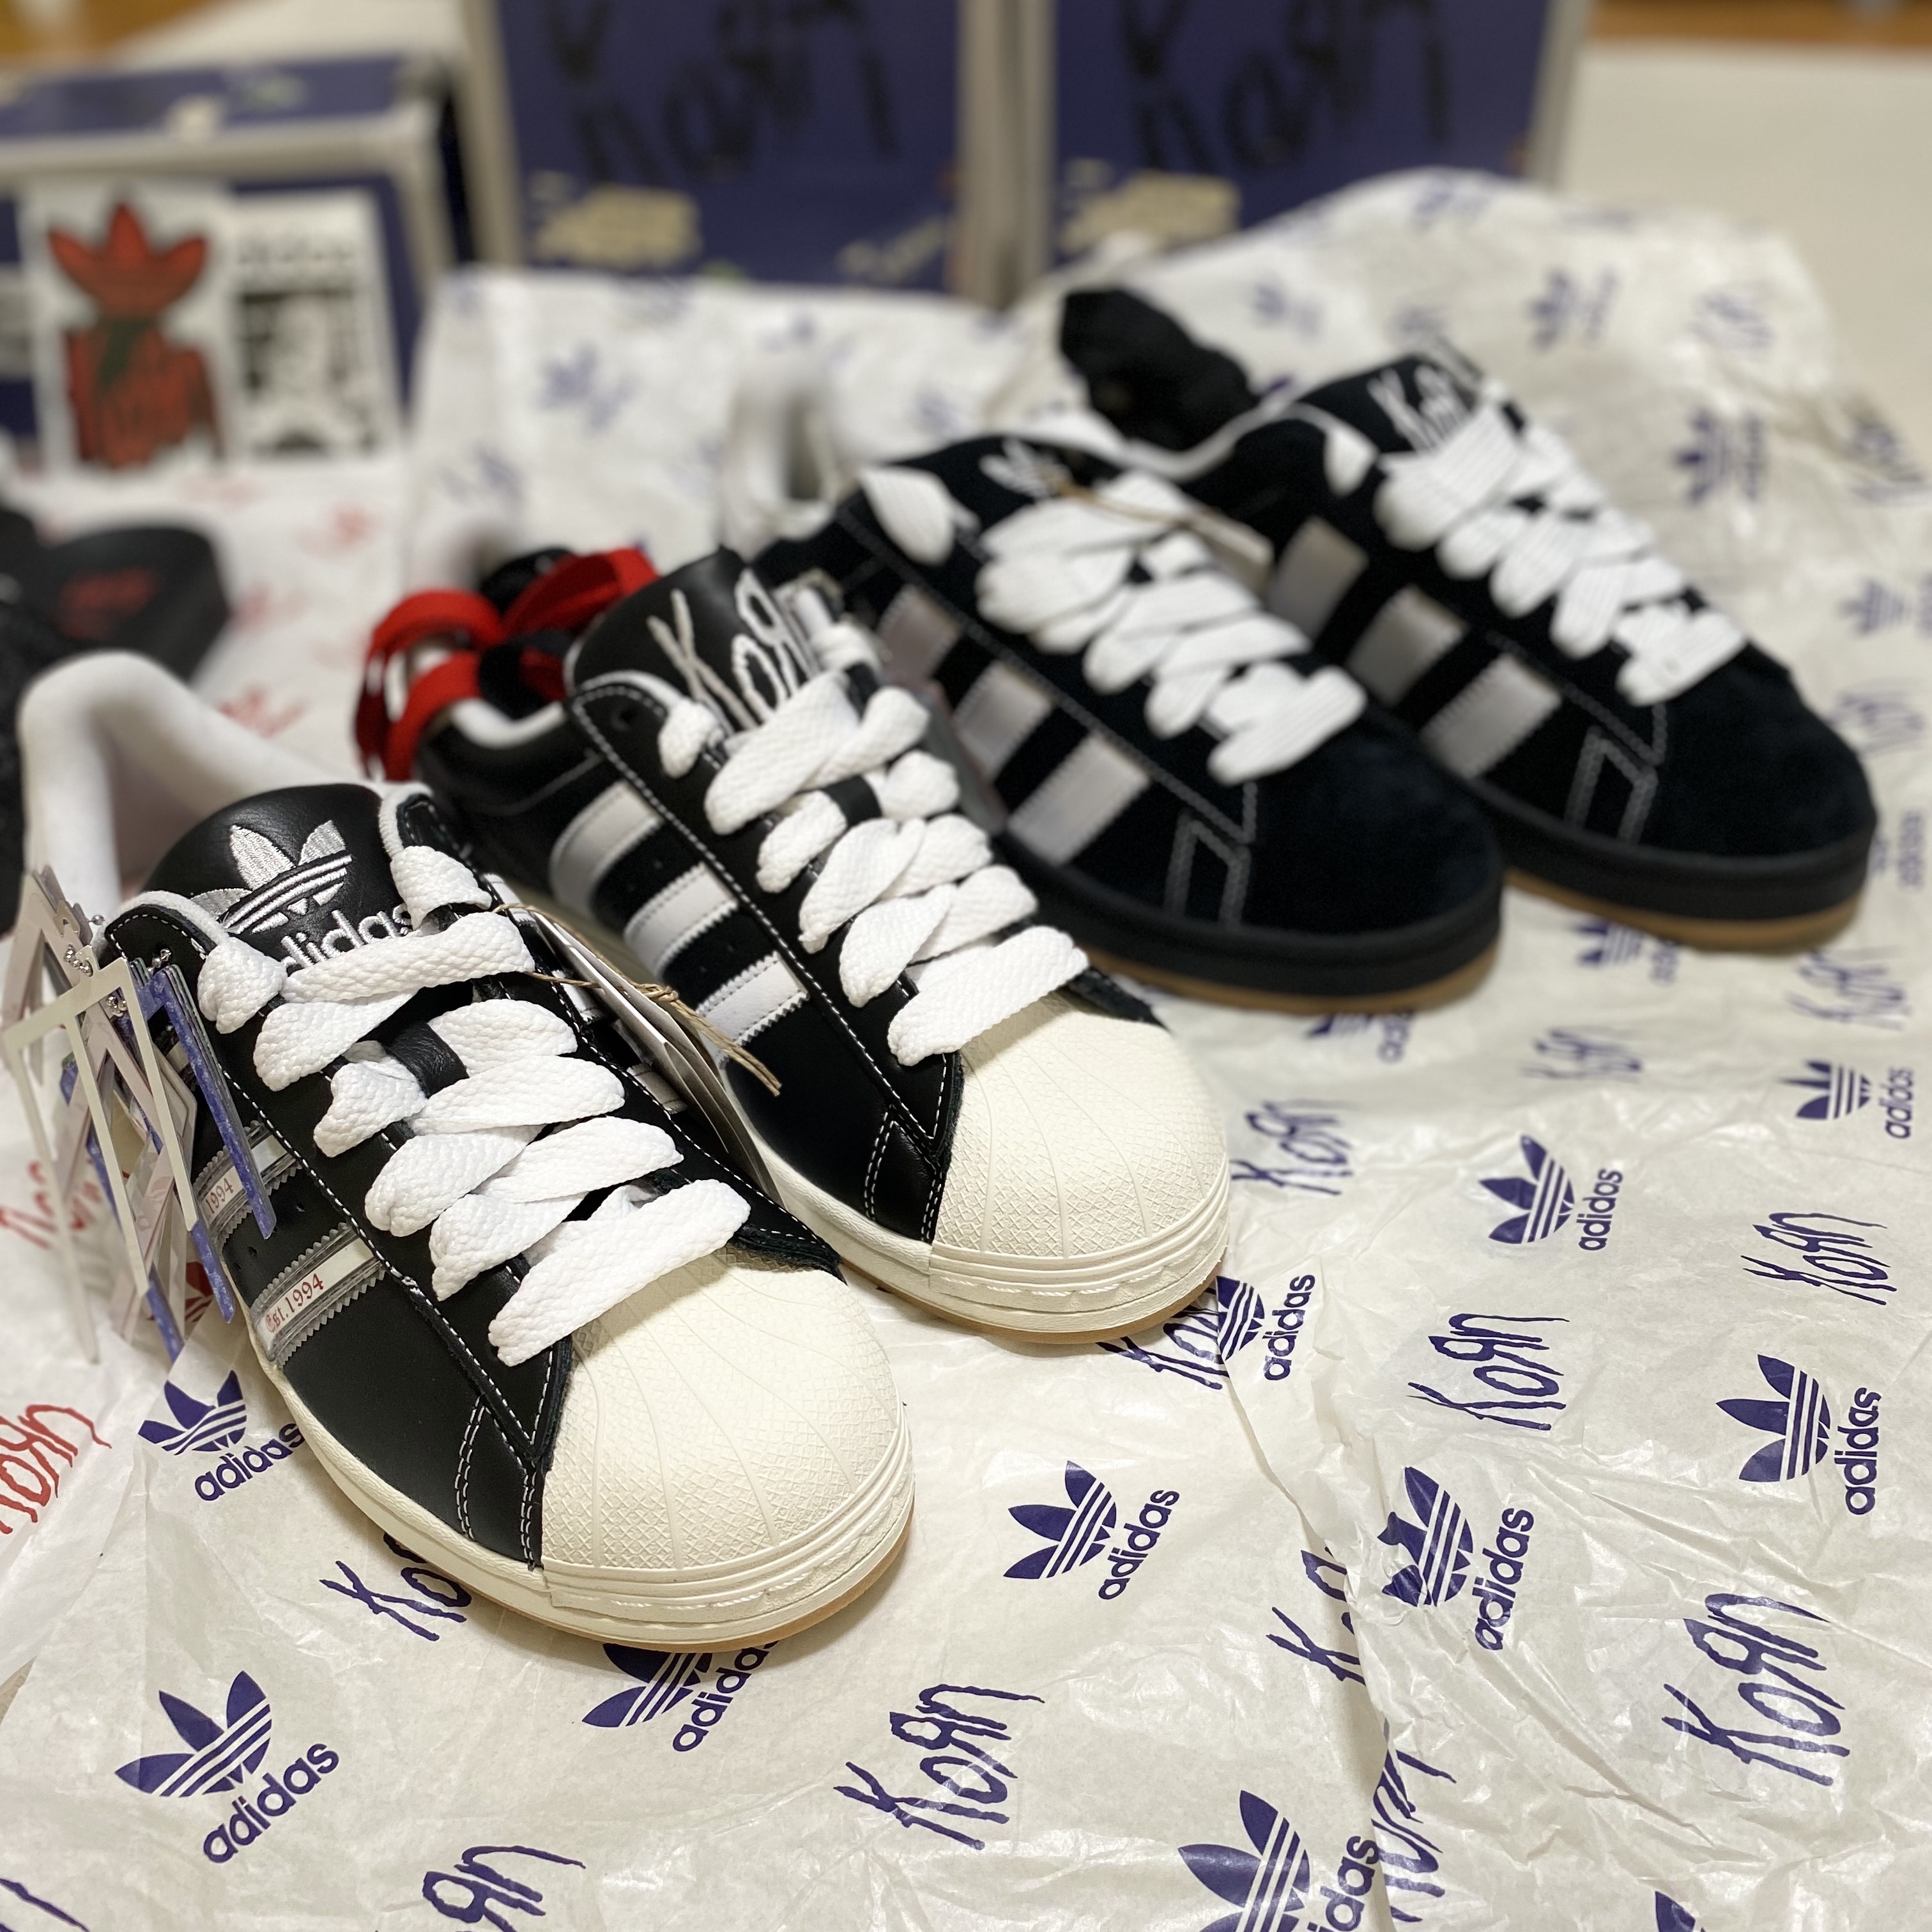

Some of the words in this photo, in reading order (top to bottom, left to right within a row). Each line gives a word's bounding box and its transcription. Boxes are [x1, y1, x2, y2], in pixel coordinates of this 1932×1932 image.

[1882, 1066, 1913, 1140] adidas
[1576, 1168, 1623, 1252] adidas
[1262, 1274, 1316, 1381] adidas
[194, 1423, 305, 1501] adidas
[1834, 1386, 1883, 1515] adidas
[1098, 1489, 1181, 1600] adidas
[1471, 1508, 1535, 1651] adidas
[671, 1641, 781, 1752] adida
[202, 1743, 340, 1864] adidas
